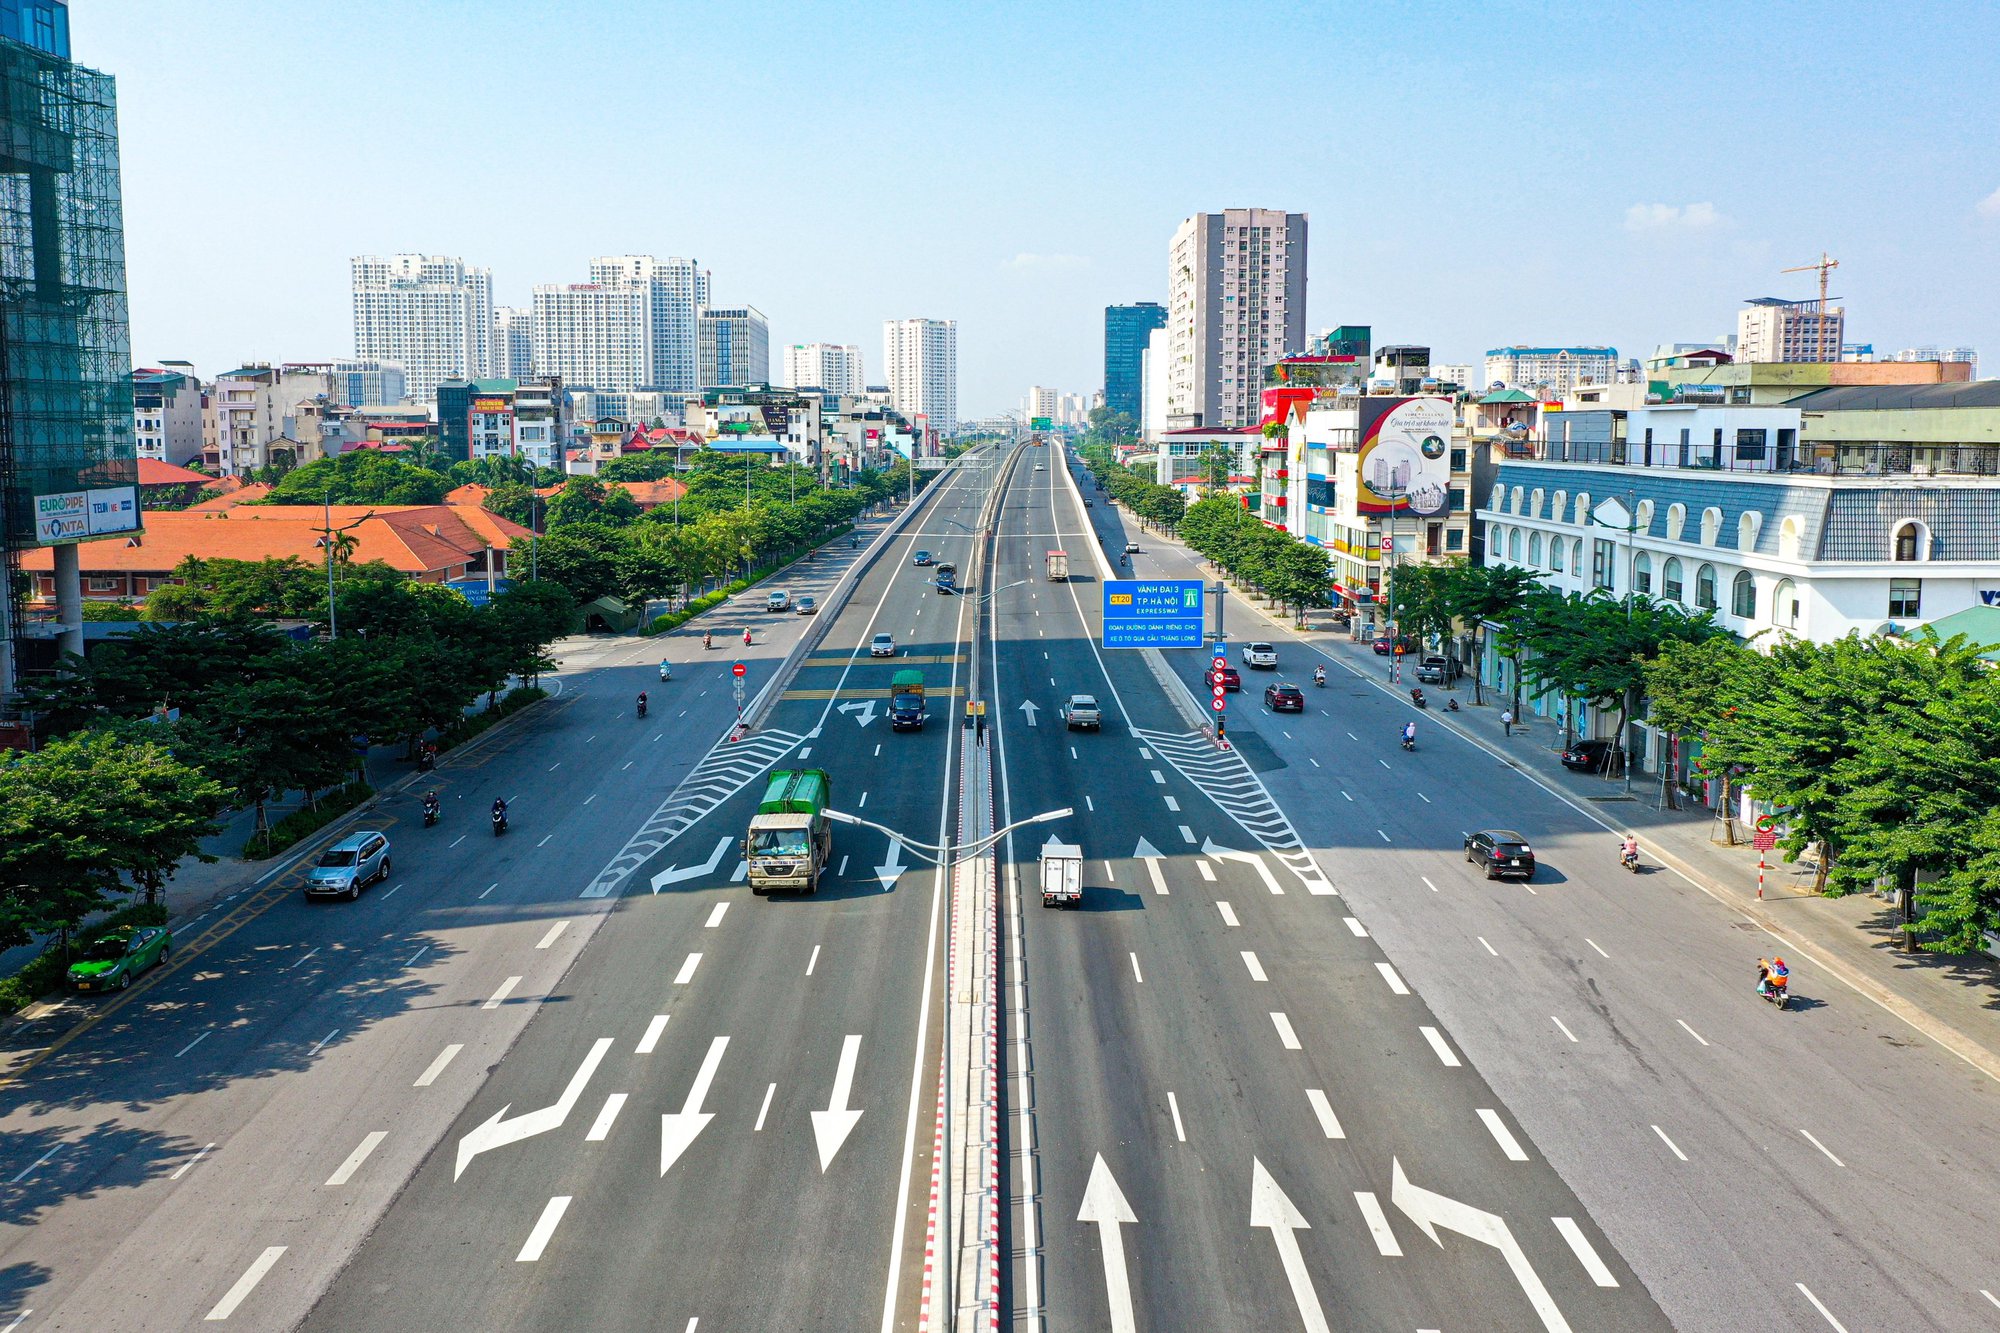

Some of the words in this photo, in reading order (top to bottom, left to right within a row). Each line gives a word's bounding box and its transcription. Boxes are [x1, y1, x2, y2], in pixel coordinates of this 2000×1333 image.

[40, 496, 84, 512] EUROPIPE
[42, 519, 85, 537] VONTA
[1137, 585, 1158, 593] VÀNH
[1151, 596, 1162, 605] HÀ
[1164, 597, 1178, 606] NỘI
